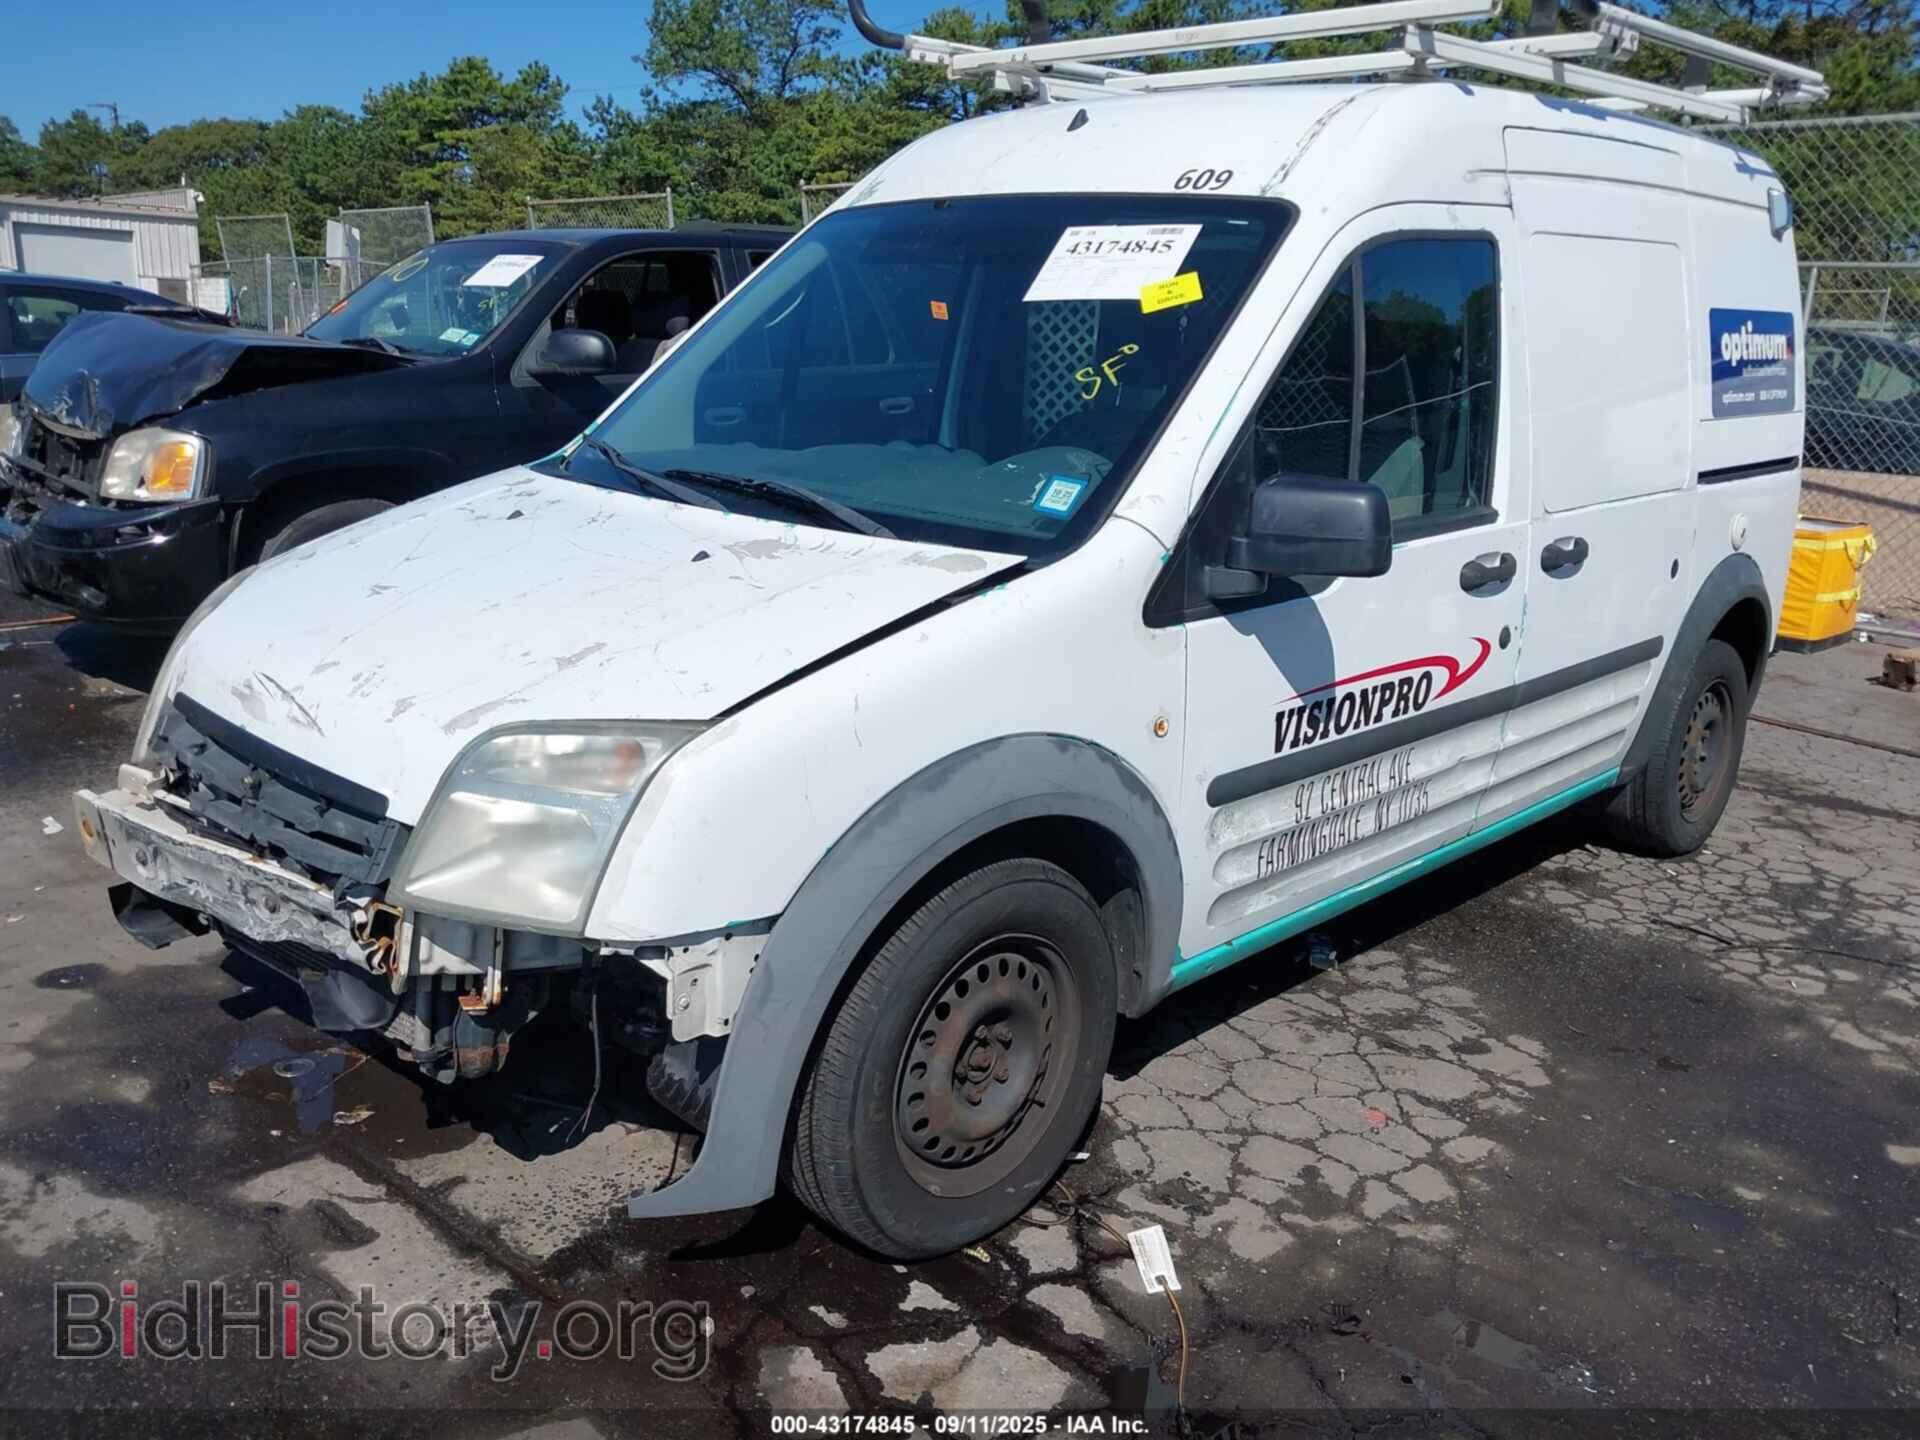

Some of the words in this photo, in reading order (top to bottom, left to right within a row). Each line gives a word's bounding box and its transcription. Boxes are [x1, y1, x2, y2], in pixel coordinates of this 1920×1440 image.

[1174, 168, 1235, 191] 609
[1065, 239, 1176, 255] 43174845
[1721, 320, 1788, 367] optimum
[1274, 670, 1433, 754] VISIONPRO
[1294, 781, 1315, 824] 92
[1320, 758, 1384, 814] CENTRAL
[1388, 747, 1415, 787] AVE
